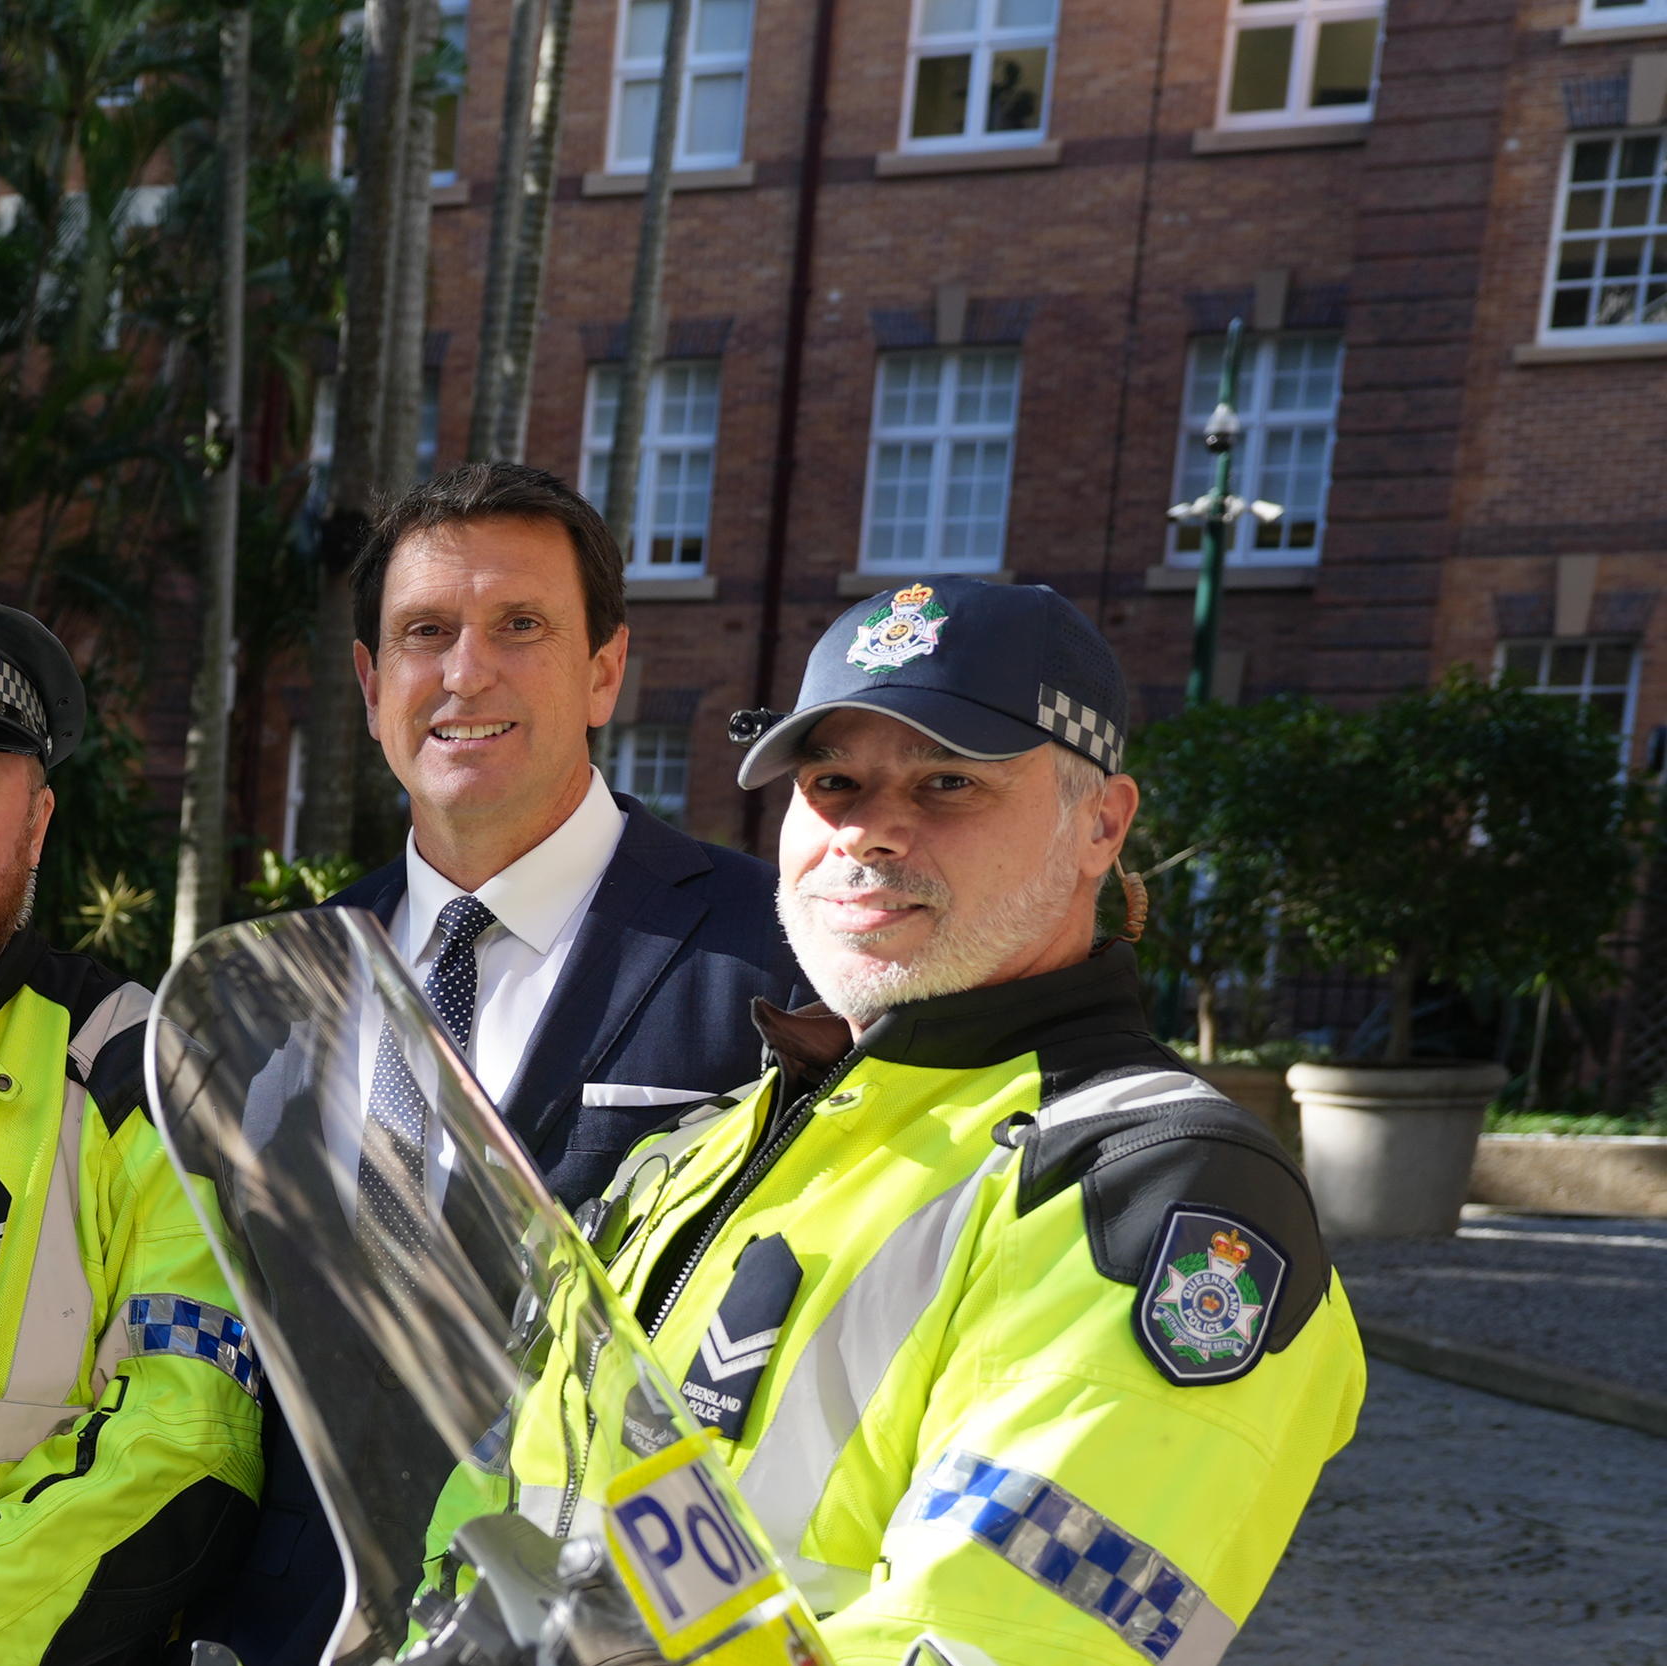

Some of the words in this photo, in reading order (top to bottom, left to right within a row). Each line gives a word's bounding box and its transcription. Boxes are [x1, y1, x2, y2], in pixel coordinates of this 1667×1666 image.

[873, 640, 912, 653] POLICE
[1182, 1272, 1239, 1320] QUEENSLAND
[1183, 1308, 1225, 1332] POLICE
[681, 1381, 742, 1412] QUEENSLAND
[688, 1400, 722, 1422] POLICE
